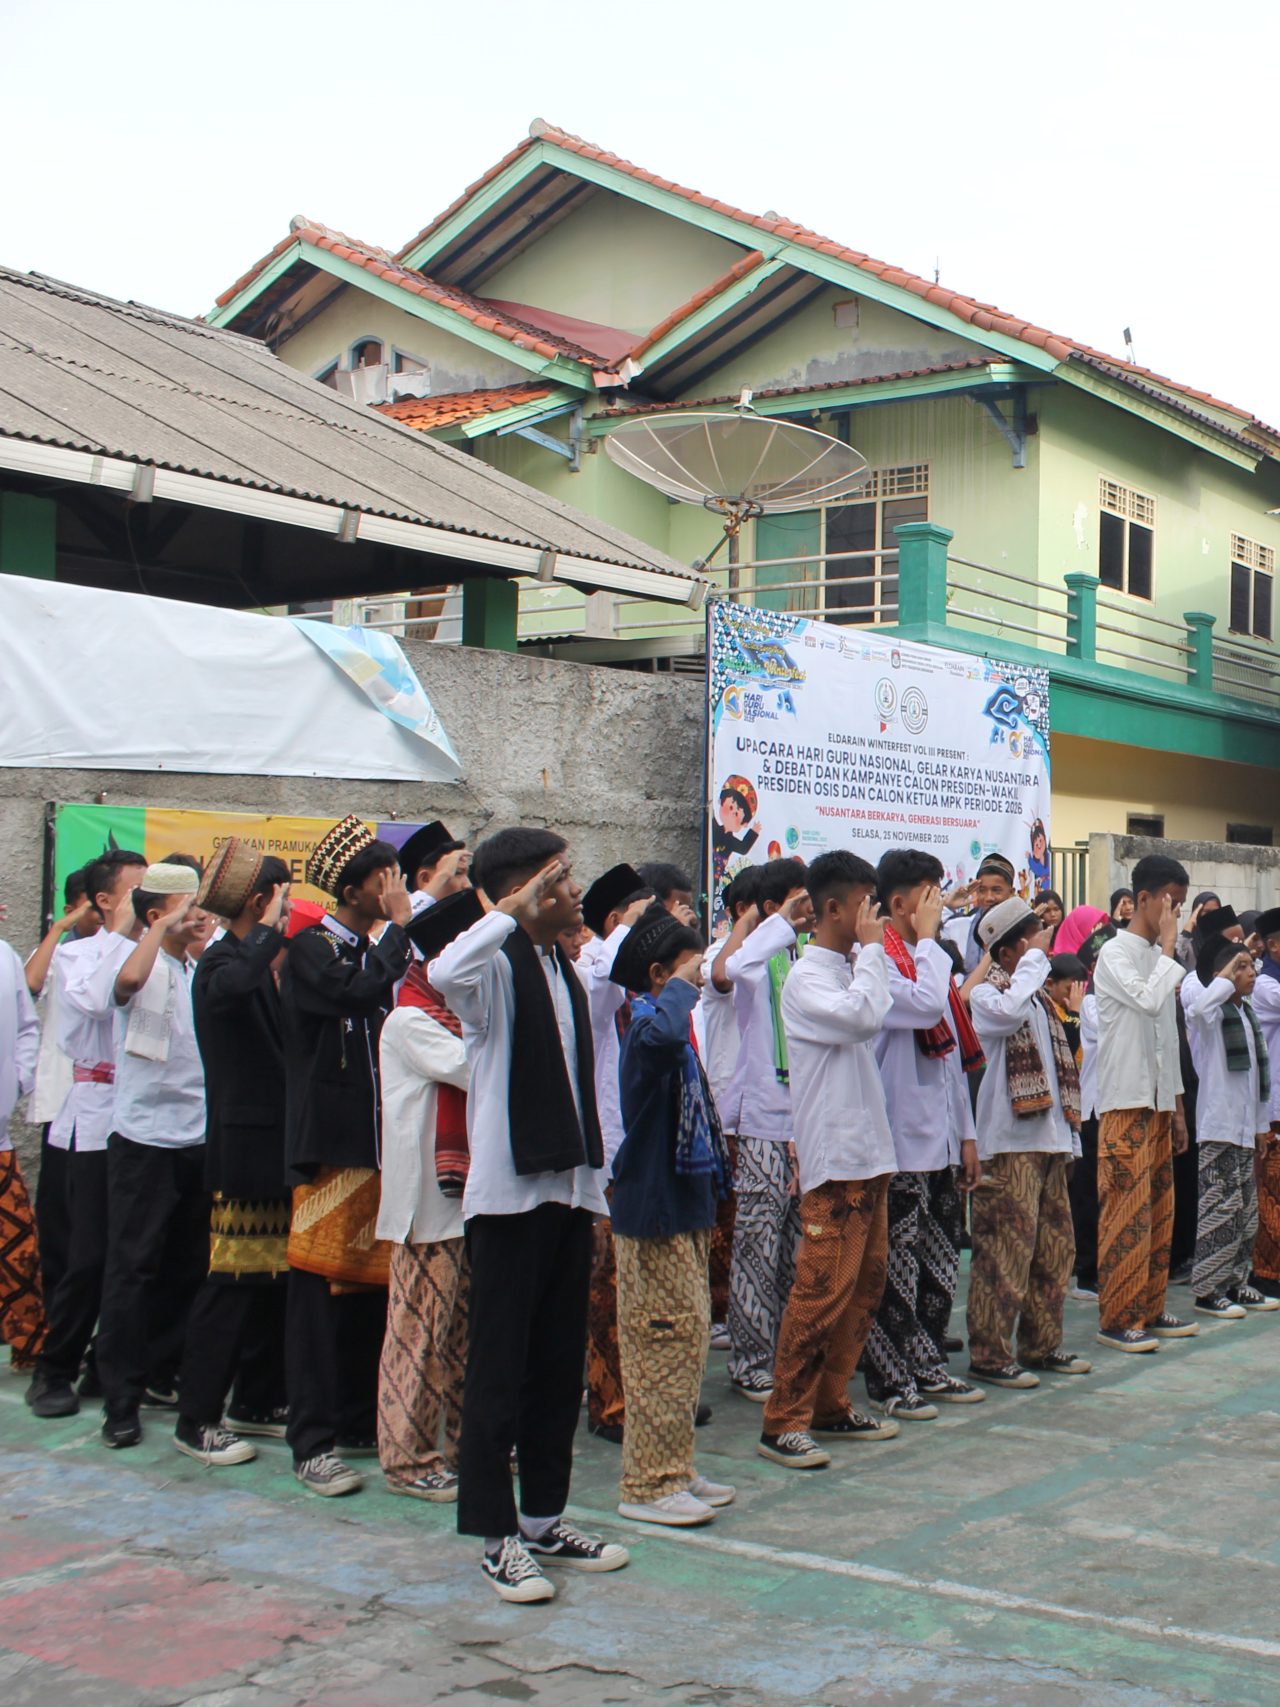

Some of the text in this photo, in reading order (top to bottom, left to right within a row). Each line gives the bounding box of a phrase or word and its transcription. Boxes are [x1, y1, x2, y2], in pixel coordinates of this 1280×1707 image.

[744, 692, 763, 702] HARI
[744, 700, 764, 710] GURU
[828, 733, 866, 747] ELDARAIN
[867, 738, 912, 753] WINTERFEST
[913, 746, 928, 756] VOL
[928, 747, 936, 756] III
[936, 748, 965, 760] PRESENT
[736, 737, 1040, 787] UPACARA HARI GURU NASIONAL, GELAR KARYA NUSANTARA
[762, 758, 1019, 800] & DEBAT DAN KAMPANYE CALON PRESIDEN-WAKIL
[757, 775, 1023, 815] PRESIDEN OSIS DAN CALON KETUA MPK PERIODE 2026
[867, 810, 907, 824] BERKARYA,
[908, 814, 942, 826] GENERASI
[852, 828, 949, 844] SELASA, 25 NOVEMBER 2025
[268, 840, 318, 852] PRAMUKA
